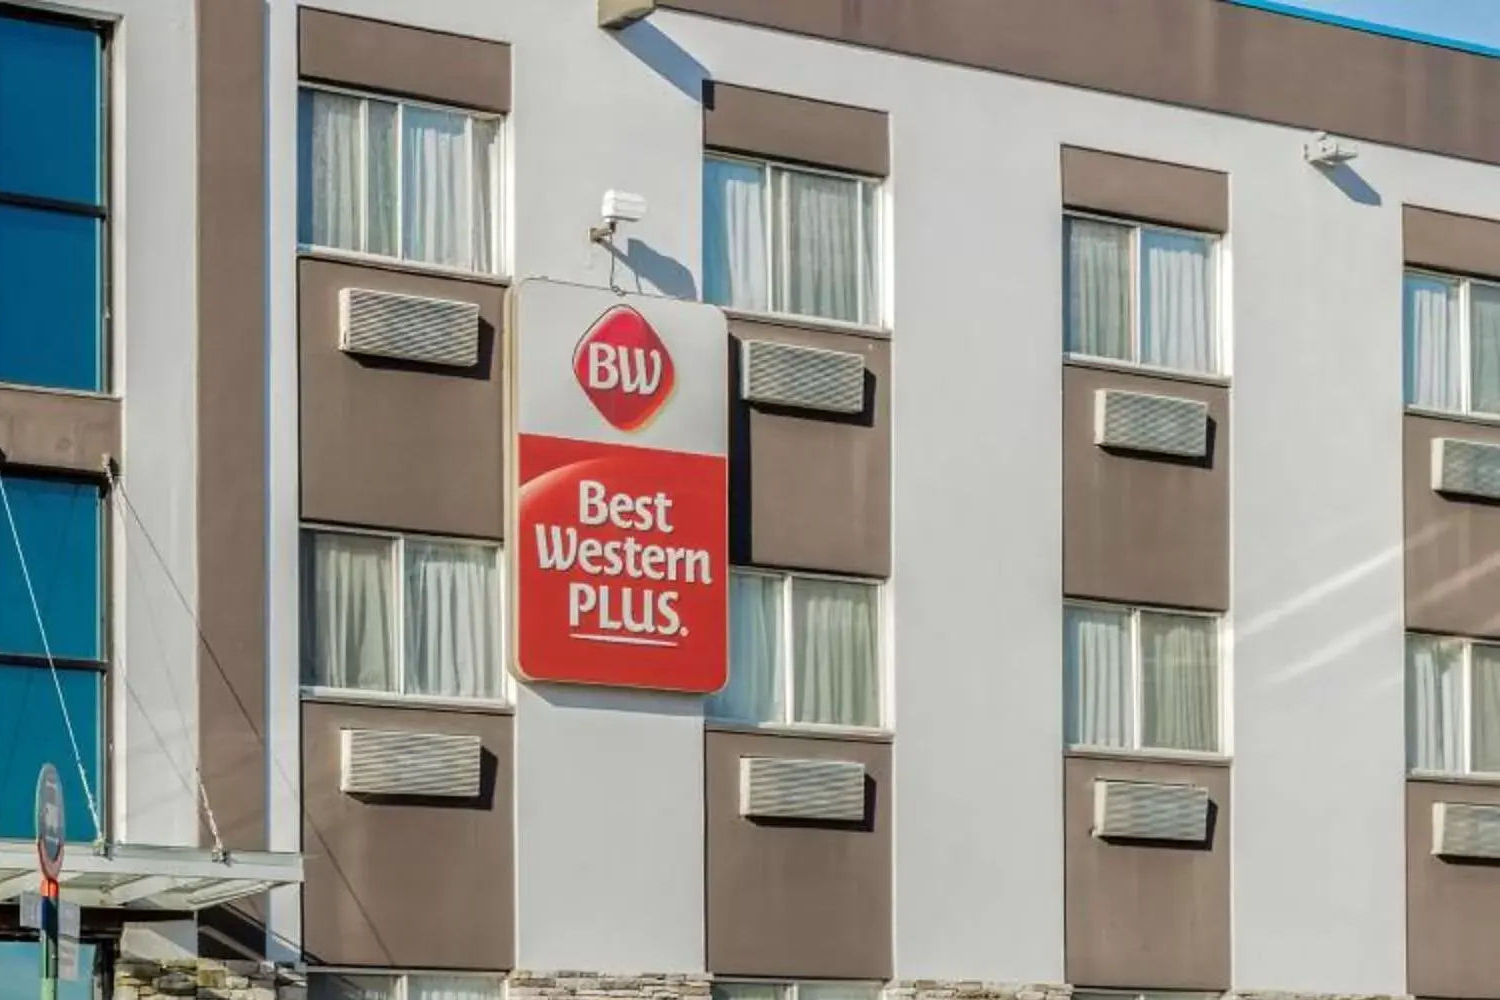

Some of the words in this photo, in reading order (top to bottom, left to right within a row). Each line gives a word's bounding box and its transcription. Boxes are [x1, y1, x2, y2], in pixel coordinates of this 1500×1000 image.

[588, 342, 661, 396] BW
[578, 480, 673, 533] Best
[534, 523, 714, 585] Western
